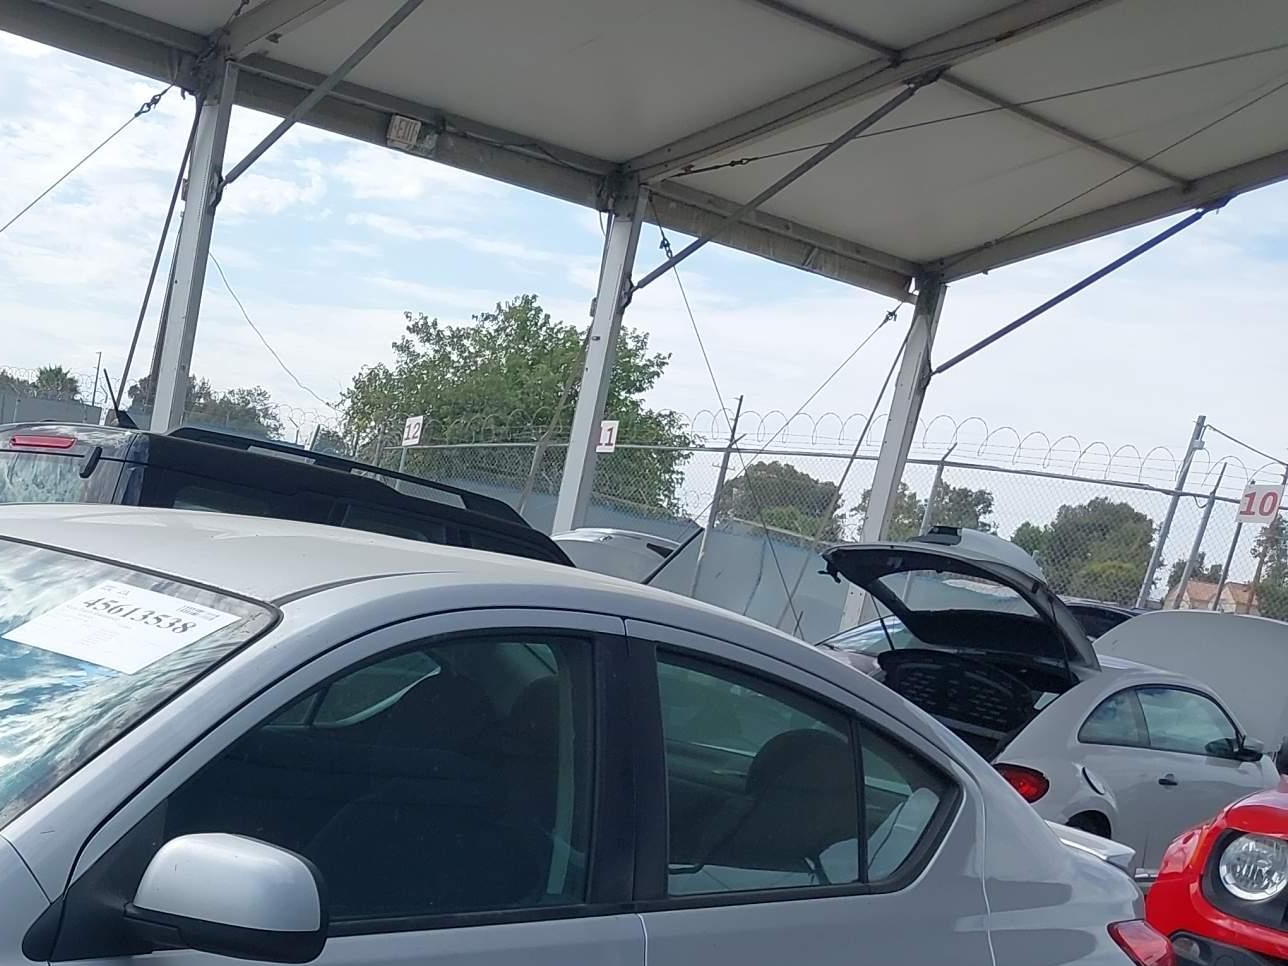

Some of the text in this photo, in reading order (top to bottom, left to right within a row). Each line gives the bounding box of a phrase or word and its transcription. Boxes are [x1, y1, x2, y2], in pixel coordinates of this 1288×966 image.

[404, 422, 421, 441] 12
[1239, 491, 1279, 517] 10
[83, 597, 197, 634] 45613538
